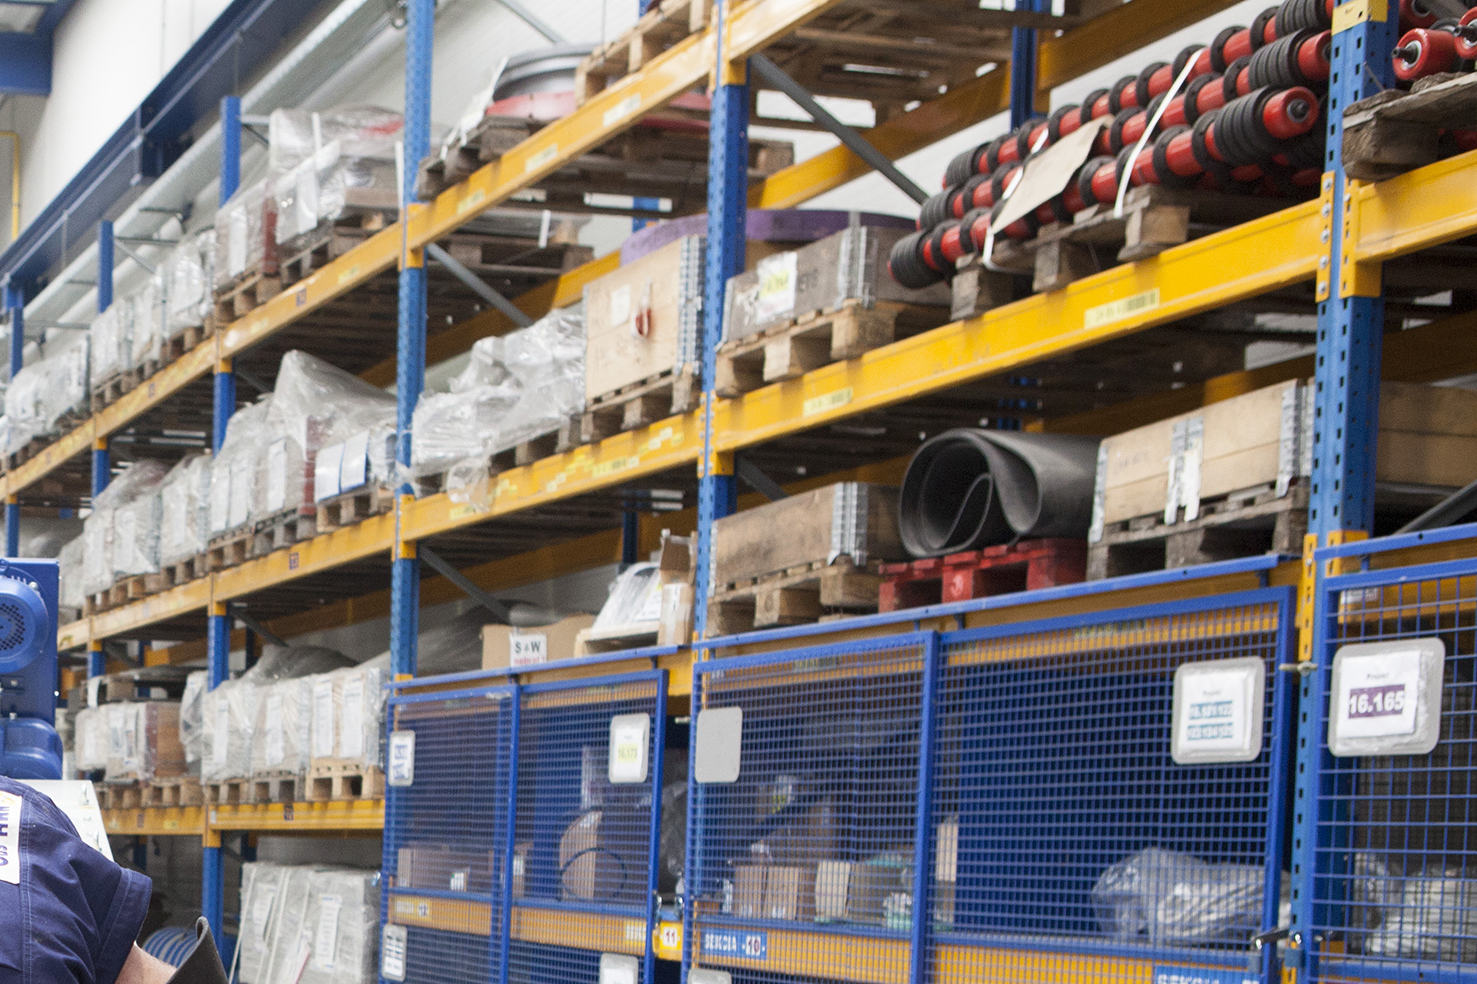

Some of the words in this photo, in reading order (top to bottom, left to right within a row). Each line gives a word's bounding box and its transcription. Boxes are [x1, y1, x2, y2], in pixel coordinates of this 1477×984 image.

[515, 641, 522, 654] S
[531, 641, 541, 653] W
[1348, 690, 1405, 715] 16.165
